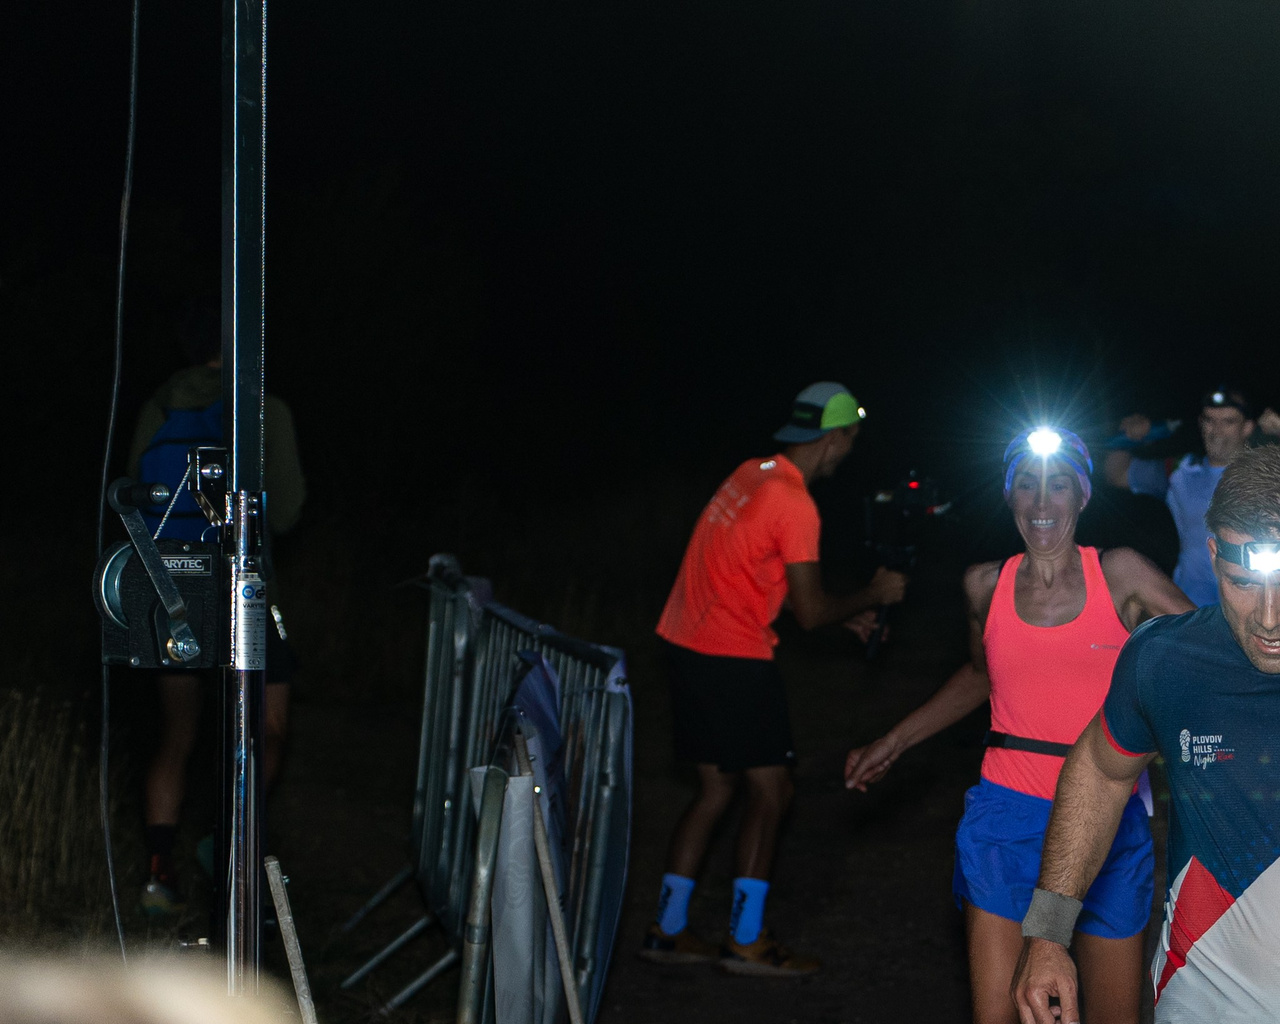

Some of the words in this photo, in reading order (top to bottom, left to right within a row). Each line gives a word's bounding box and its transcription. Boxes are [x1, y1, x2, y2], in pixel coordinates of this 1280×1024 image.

[163, 559, 203, 569] ARYTEC
[1192, 735, 1222, 744] PLOVDIV
[1193, 745, 1212, 754] HILLS
[1193, 753, 1217, 770] Night
